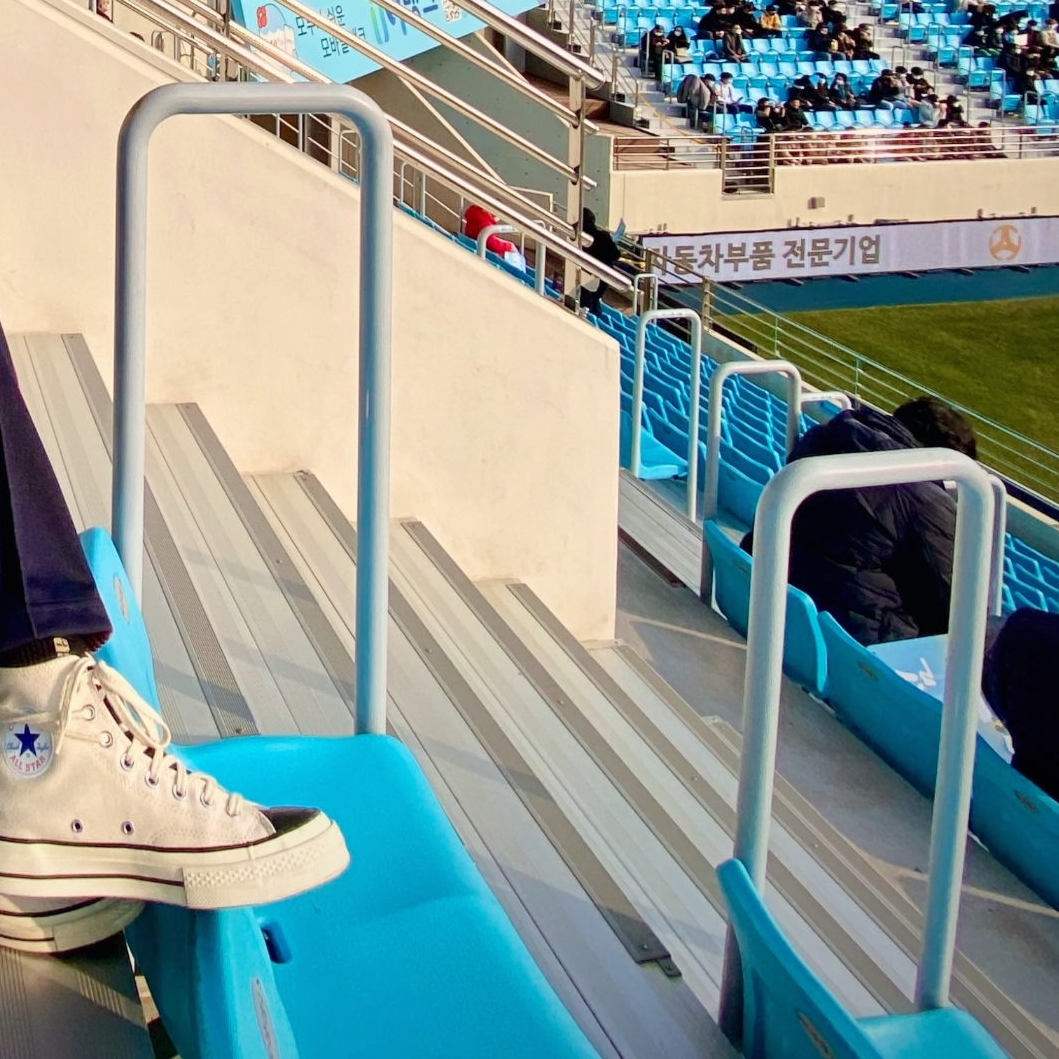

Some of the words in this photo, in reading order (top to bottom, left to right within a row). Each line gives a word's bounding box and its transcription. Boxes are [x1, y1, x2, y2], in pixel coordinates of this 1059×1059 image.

[781, 234, 882, 269] 전문기업
[9, 754, 23, 771] ALL
[25, 754, 46, 772] STAR
